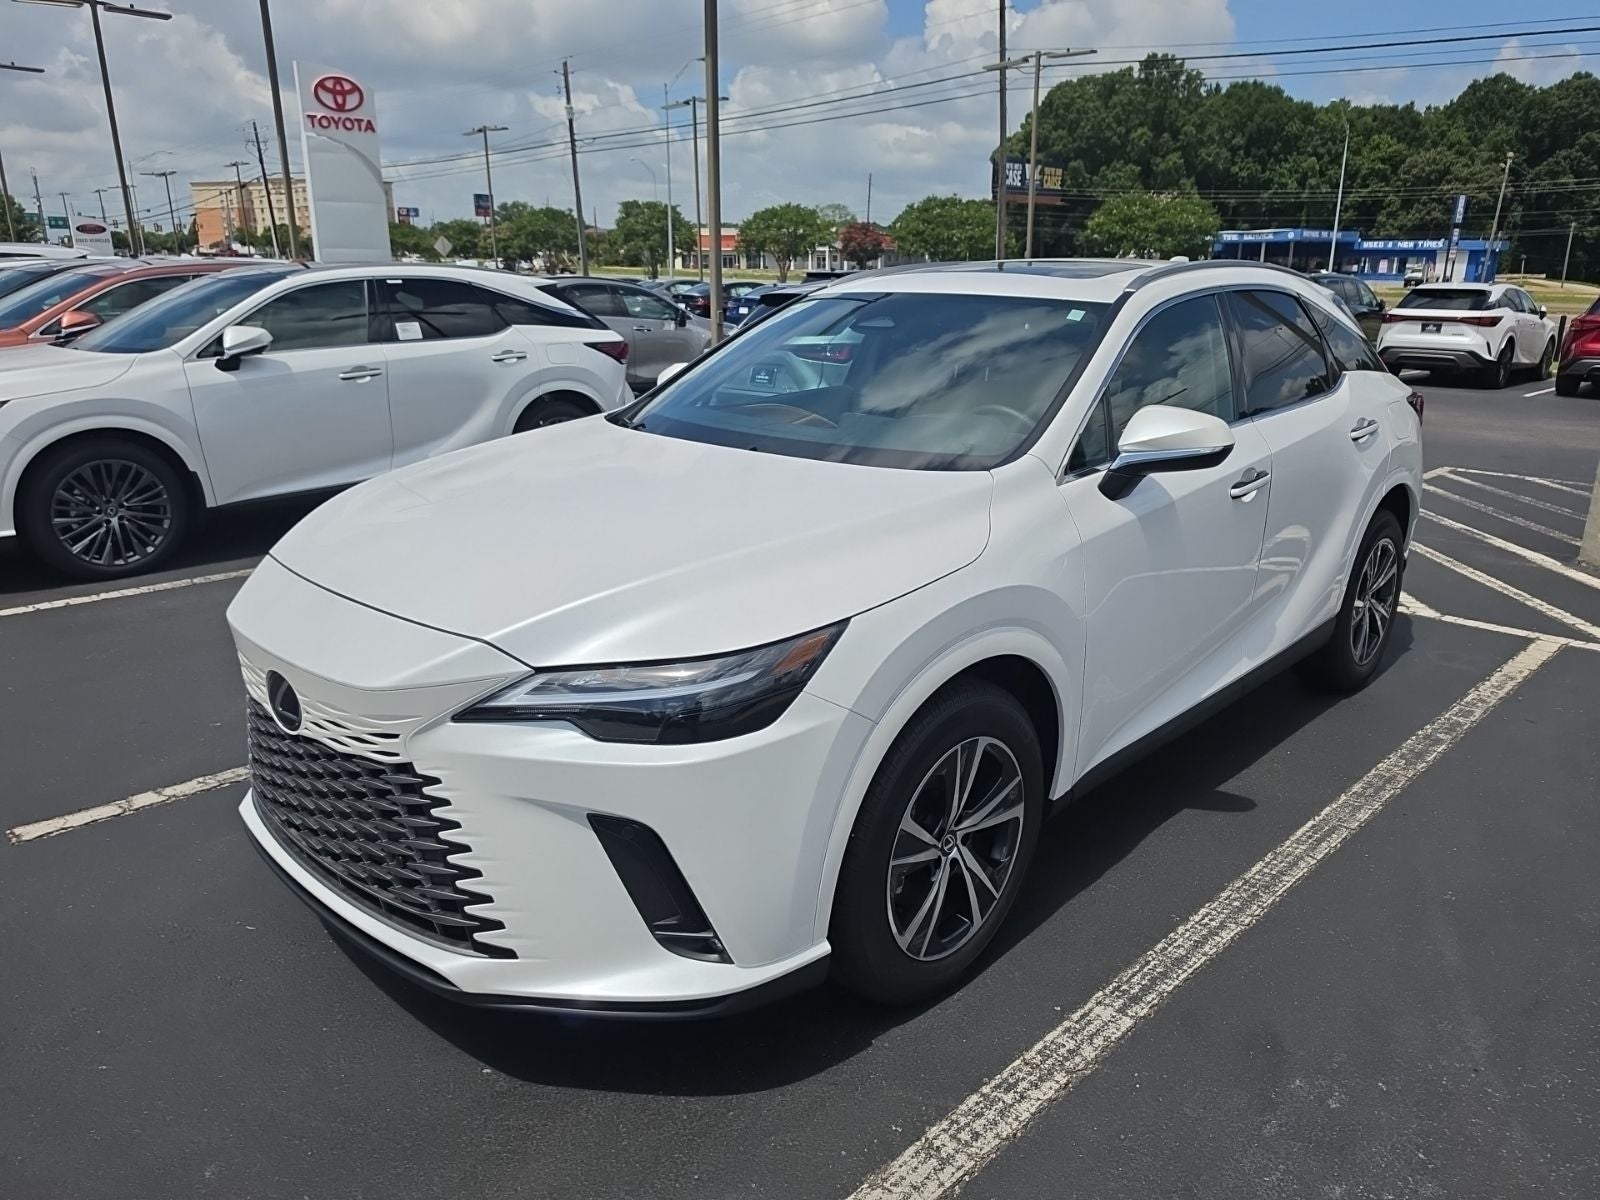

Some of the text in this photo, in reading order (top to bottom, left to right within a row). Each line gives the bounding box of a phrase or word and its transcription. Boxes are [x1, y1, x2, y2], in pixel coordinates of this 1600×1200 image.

[306, 114, 376, 133] TOYOTA
[1363, 240, 1384, 249] USED
[1397, 240, 1415, 248] NEW
[1418, 239, 1444, 248] TIRES
